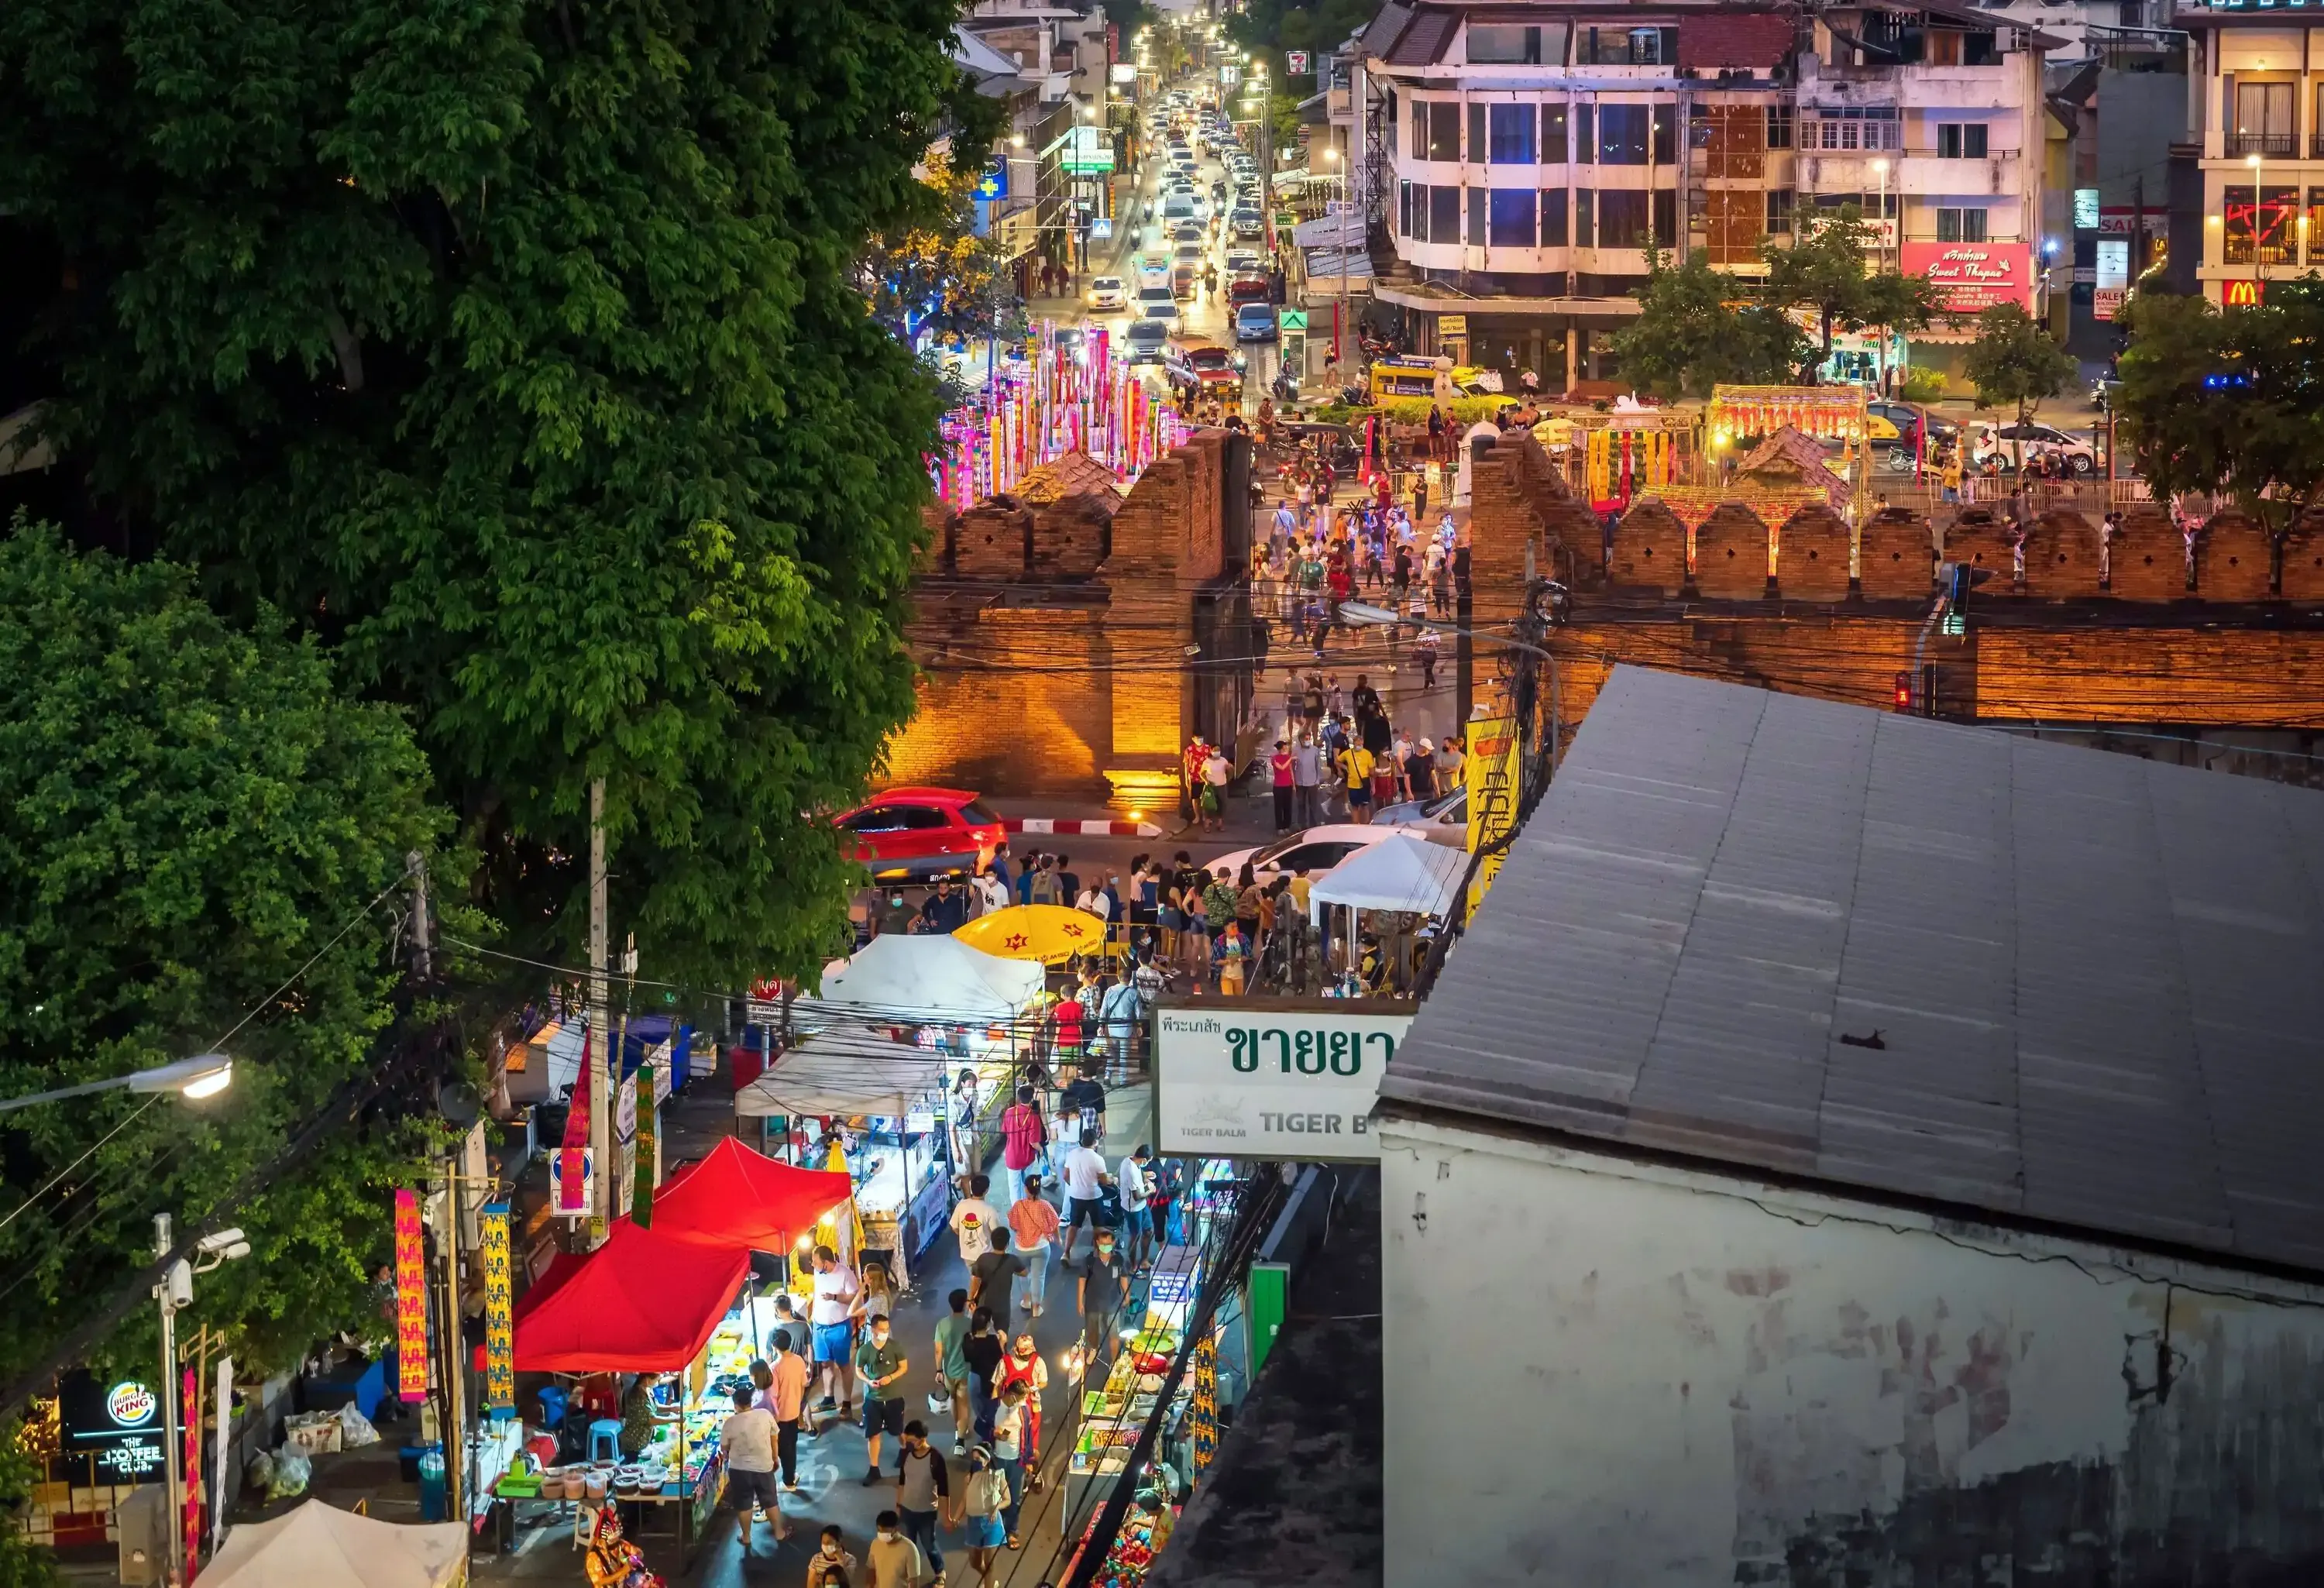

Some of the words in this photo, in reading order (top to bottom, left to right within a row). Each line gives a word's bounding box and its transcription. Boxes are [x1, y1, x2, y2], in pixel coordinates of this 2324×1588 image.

[1928, 263, 1961, 277] Sweet
[1965, 263, 2003, 281] Thapae
[2096, 292, 2119, 301] SALE
[1162, 1016, 1221, 1033] พีระเภสัช
[1225, 1027, 1394, 1076] ขายยา
[1258, 1112, 1342, 1134] TIGER
[1181, 1128, 1213, 1137] TIGER
[1215, 1129, 1246, 1137] BALM
[114, 1391, 146, 1408] BURGER
[116, 1397, 149, 1417] KING
[122, 1437, 143, 1448] THE
[105, 1446, 160, 1461] COFFEE
